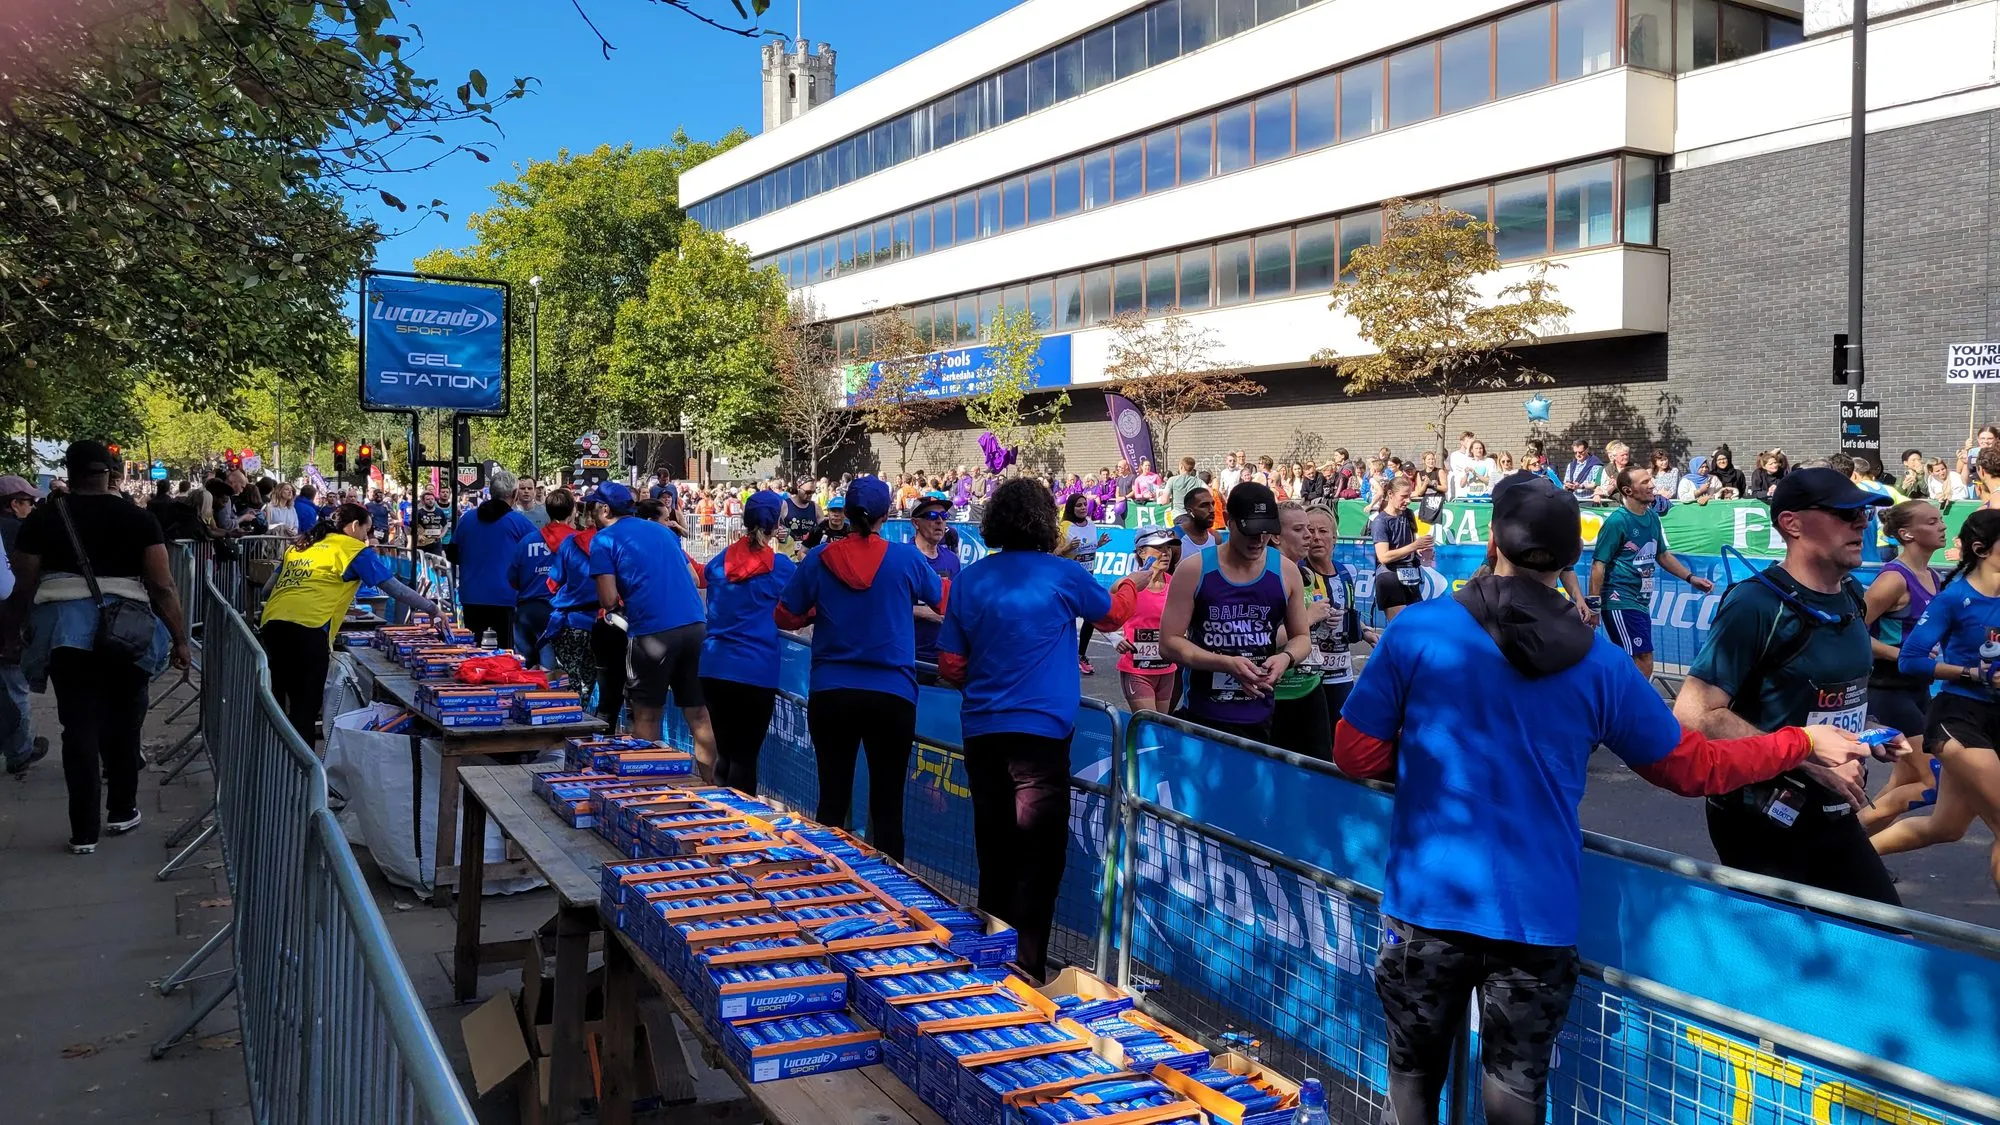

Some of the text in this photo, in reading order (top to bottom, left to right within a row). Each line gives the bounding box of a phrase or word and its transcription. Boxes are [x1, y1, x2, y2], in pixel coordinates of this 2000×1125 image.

[372, 300, 479, 327] Lucozade
[396, 324, 453, 336] SPORT
[407, 352, 463, 368] GEL
[380, 370, 489, 390] STATION
[1948, 369, 2000, 380] SO WEL
[1848, 392, 1855, 400] 2
[1841, 405, 1878, 418] Go Team!
[1842, 439, 1879, 449] Let's do this!
[527, 542, 552, 558] IT'S
[1209, 604, 1270, 620] BAILEY
[1203, 620, 1264, 633] CROHN'S
[1139, 645, 1160, 656] 423
[1818, 689, 1844, 708] tcs
[751, 992, 797, 1007] Lucozade
[757, 1003, 788, 1013] SPORT
[784, 1052, 830, 1069] Lucozade
[789, 1064, 821, 1075] SPORT
